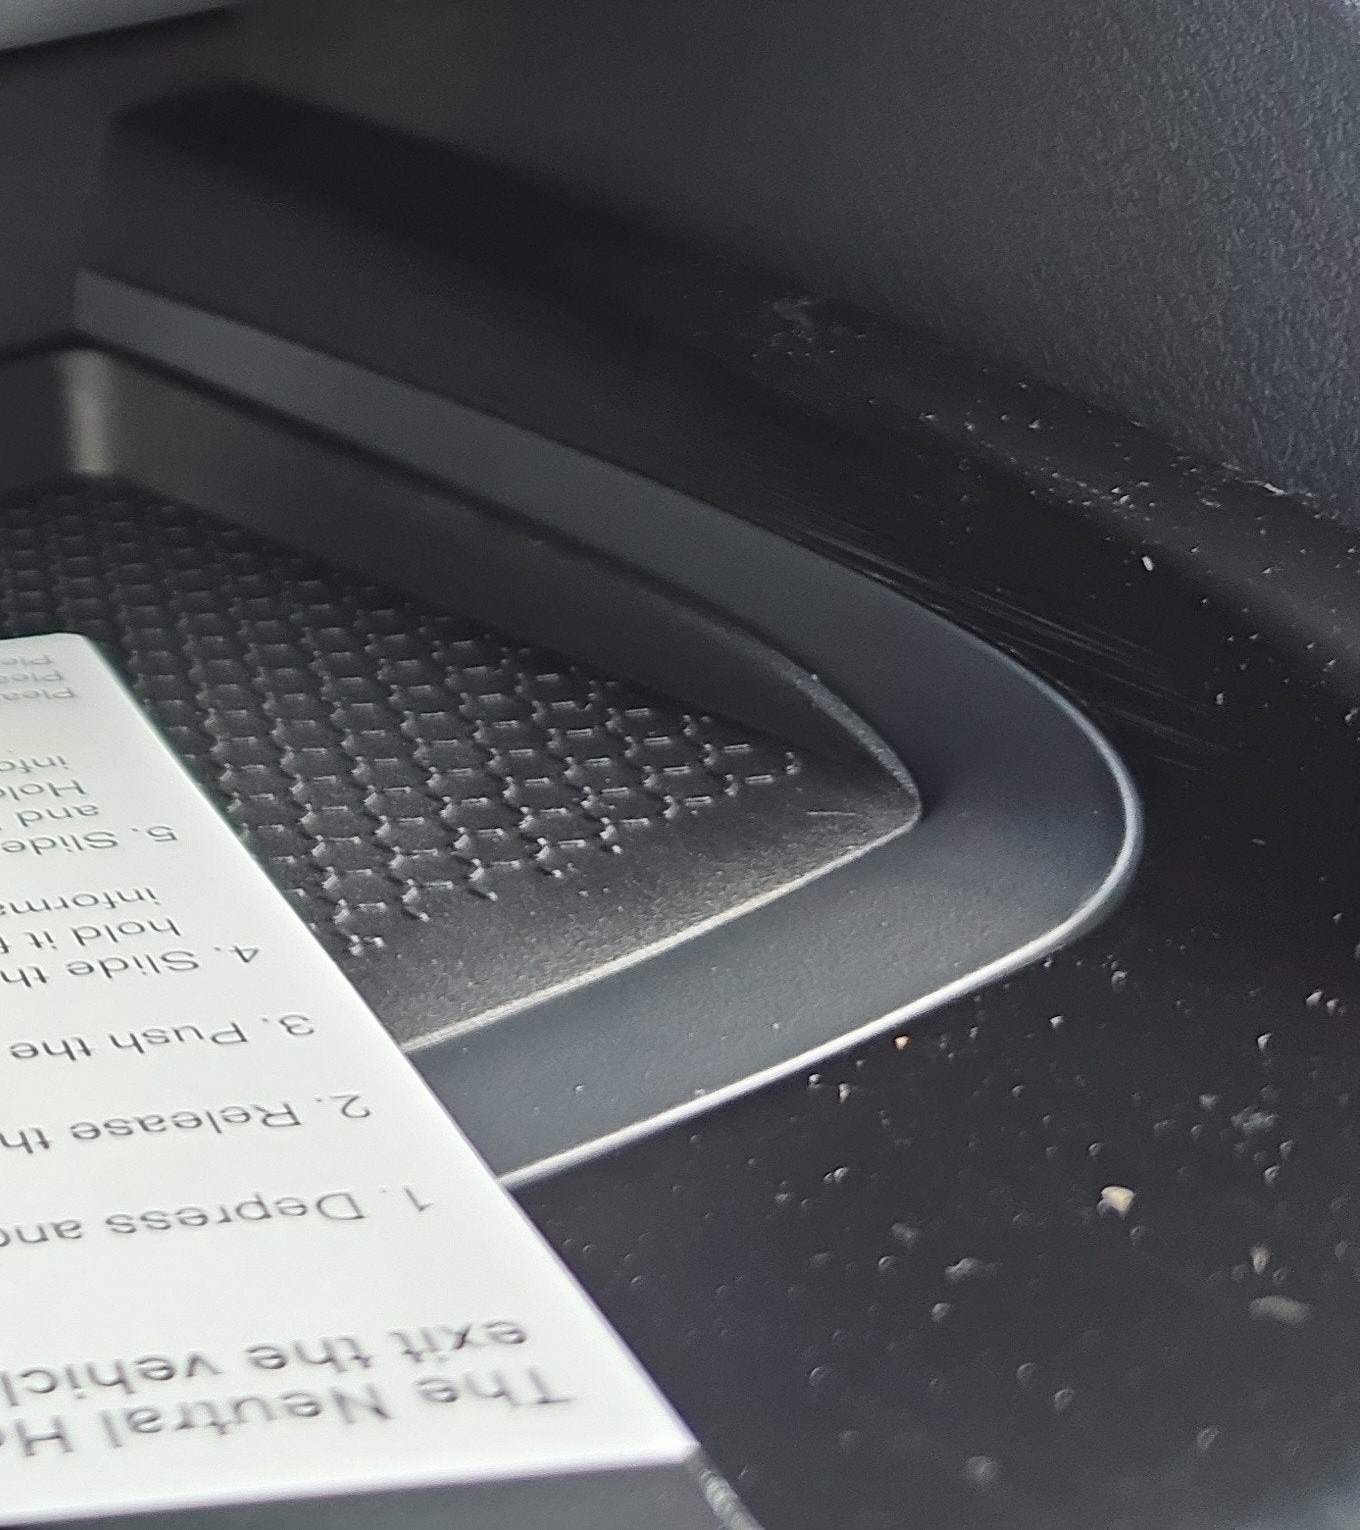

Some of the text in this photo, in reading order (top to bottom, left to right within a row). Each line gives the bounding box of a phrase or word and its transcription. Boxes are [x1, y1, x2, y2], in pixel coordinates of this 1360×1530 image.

[16, 805, 99, 828] and
[2, 832, 118, 856] Slide
[132, 826, 177, 842] 5.
[26, 931, 57, 950] it
[72, 919, 181, 947] hold
[67, 951, 199, 979] Slide
[215, 946, 259, 963] 4.
[109, 1022, 248, 1054] Push
[262, 1015, 314, 1036] 3.
[10, 1038, 92, 1062] the
[317, 1095, 371, 1119] 2.
[70, 1103, 301, 1141] Release
[105, 1193, 366, 1235] Depress
[245, 1337, 372, 1373] the
[390, 1321, 527, 1364] exit
[417, 1370, 572, 1408] The
[102, 1387, 392, 1448] Neutral
